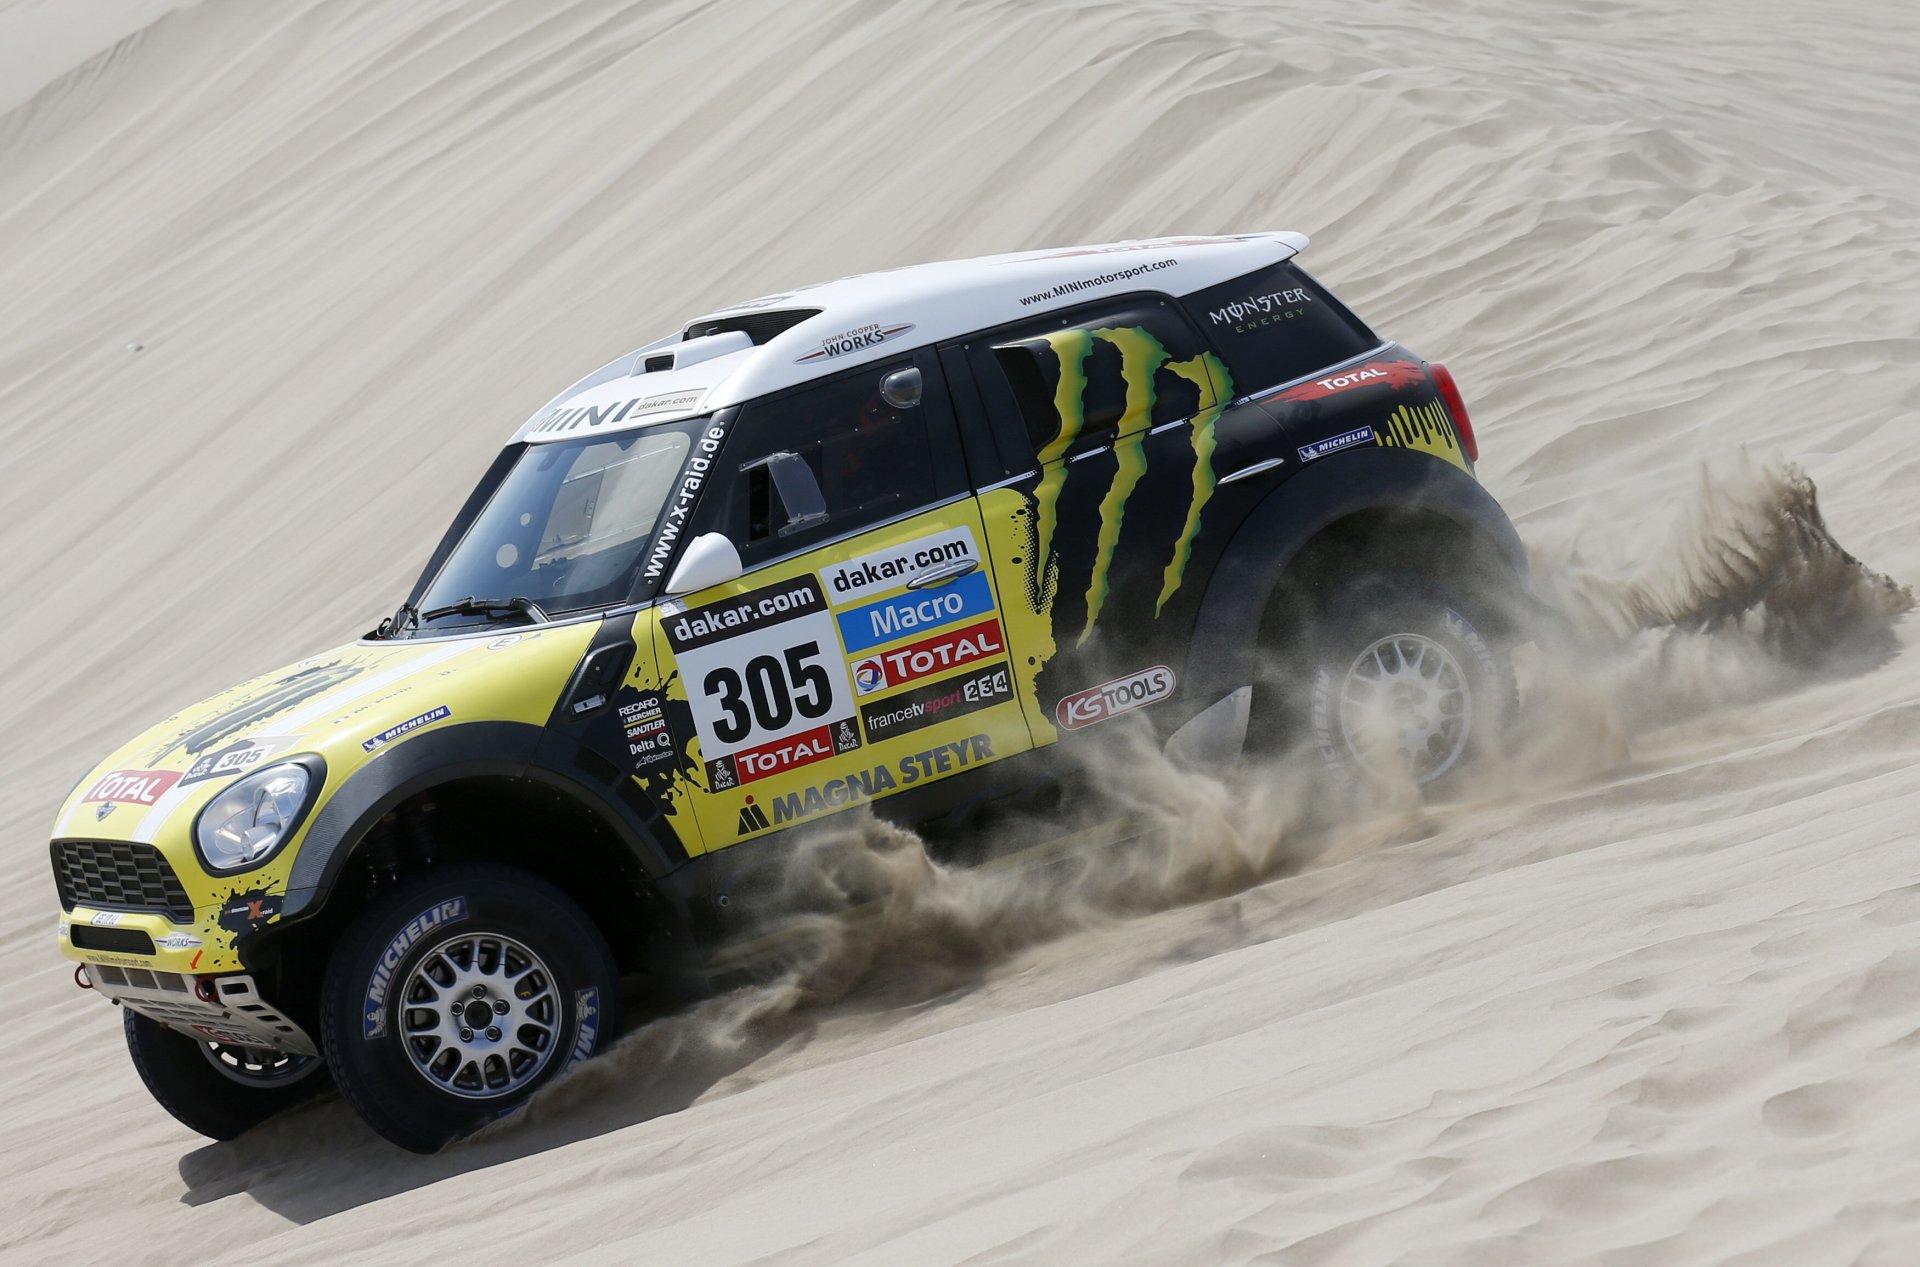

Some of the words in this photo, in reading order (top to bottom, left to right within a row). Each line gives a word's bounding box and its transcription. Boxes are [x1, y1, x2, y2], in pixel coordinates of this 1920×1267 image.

[1019, 257, 1178, 306] www.MINImotorsport.com
[821, 334, 844, 347] JOHN
[846, 323, 880, 338] COOPER
[1235, 308, 1304, 333] ENERGY
[824, 329, 885, 357] WORKS
[1316, 367, 1388, 390] TOTAL
[532, 397, 643, 433] MINI
[637, 396, 698, 411] dakar.com
[1319, 430, 1369, 452] MICHELIN
[644, 426, 725, 578] www.x-raid.de
[832, 537, 970, 594] dakar.com
[674, 585, 815, 642] dakar.com
[870, 592, 963, 638] Macro
[886, 632, 1000, 679] TOTAL
[618, 698, 659, 717] RECARO
[703, 640, 833, 744] 305
[1067, 693, 1103, 725] KS
[1101, 673, 1167, 709] TOOLS
[385, 708, 446, 740] MICHELIN
[627, 719, 665, 738] SANDTLER
[220, 749, 265, 768] 305
[629, 740, 656, 755] Delta
[738, 738, 830, 774] TOTAL
[89, 772, 163, 802] TOTAL
[772, 764, 897, 825] MAGNA
[899, 733, 995, 784] STEYR
[369, 900, 460, 1005] MICHELIN
